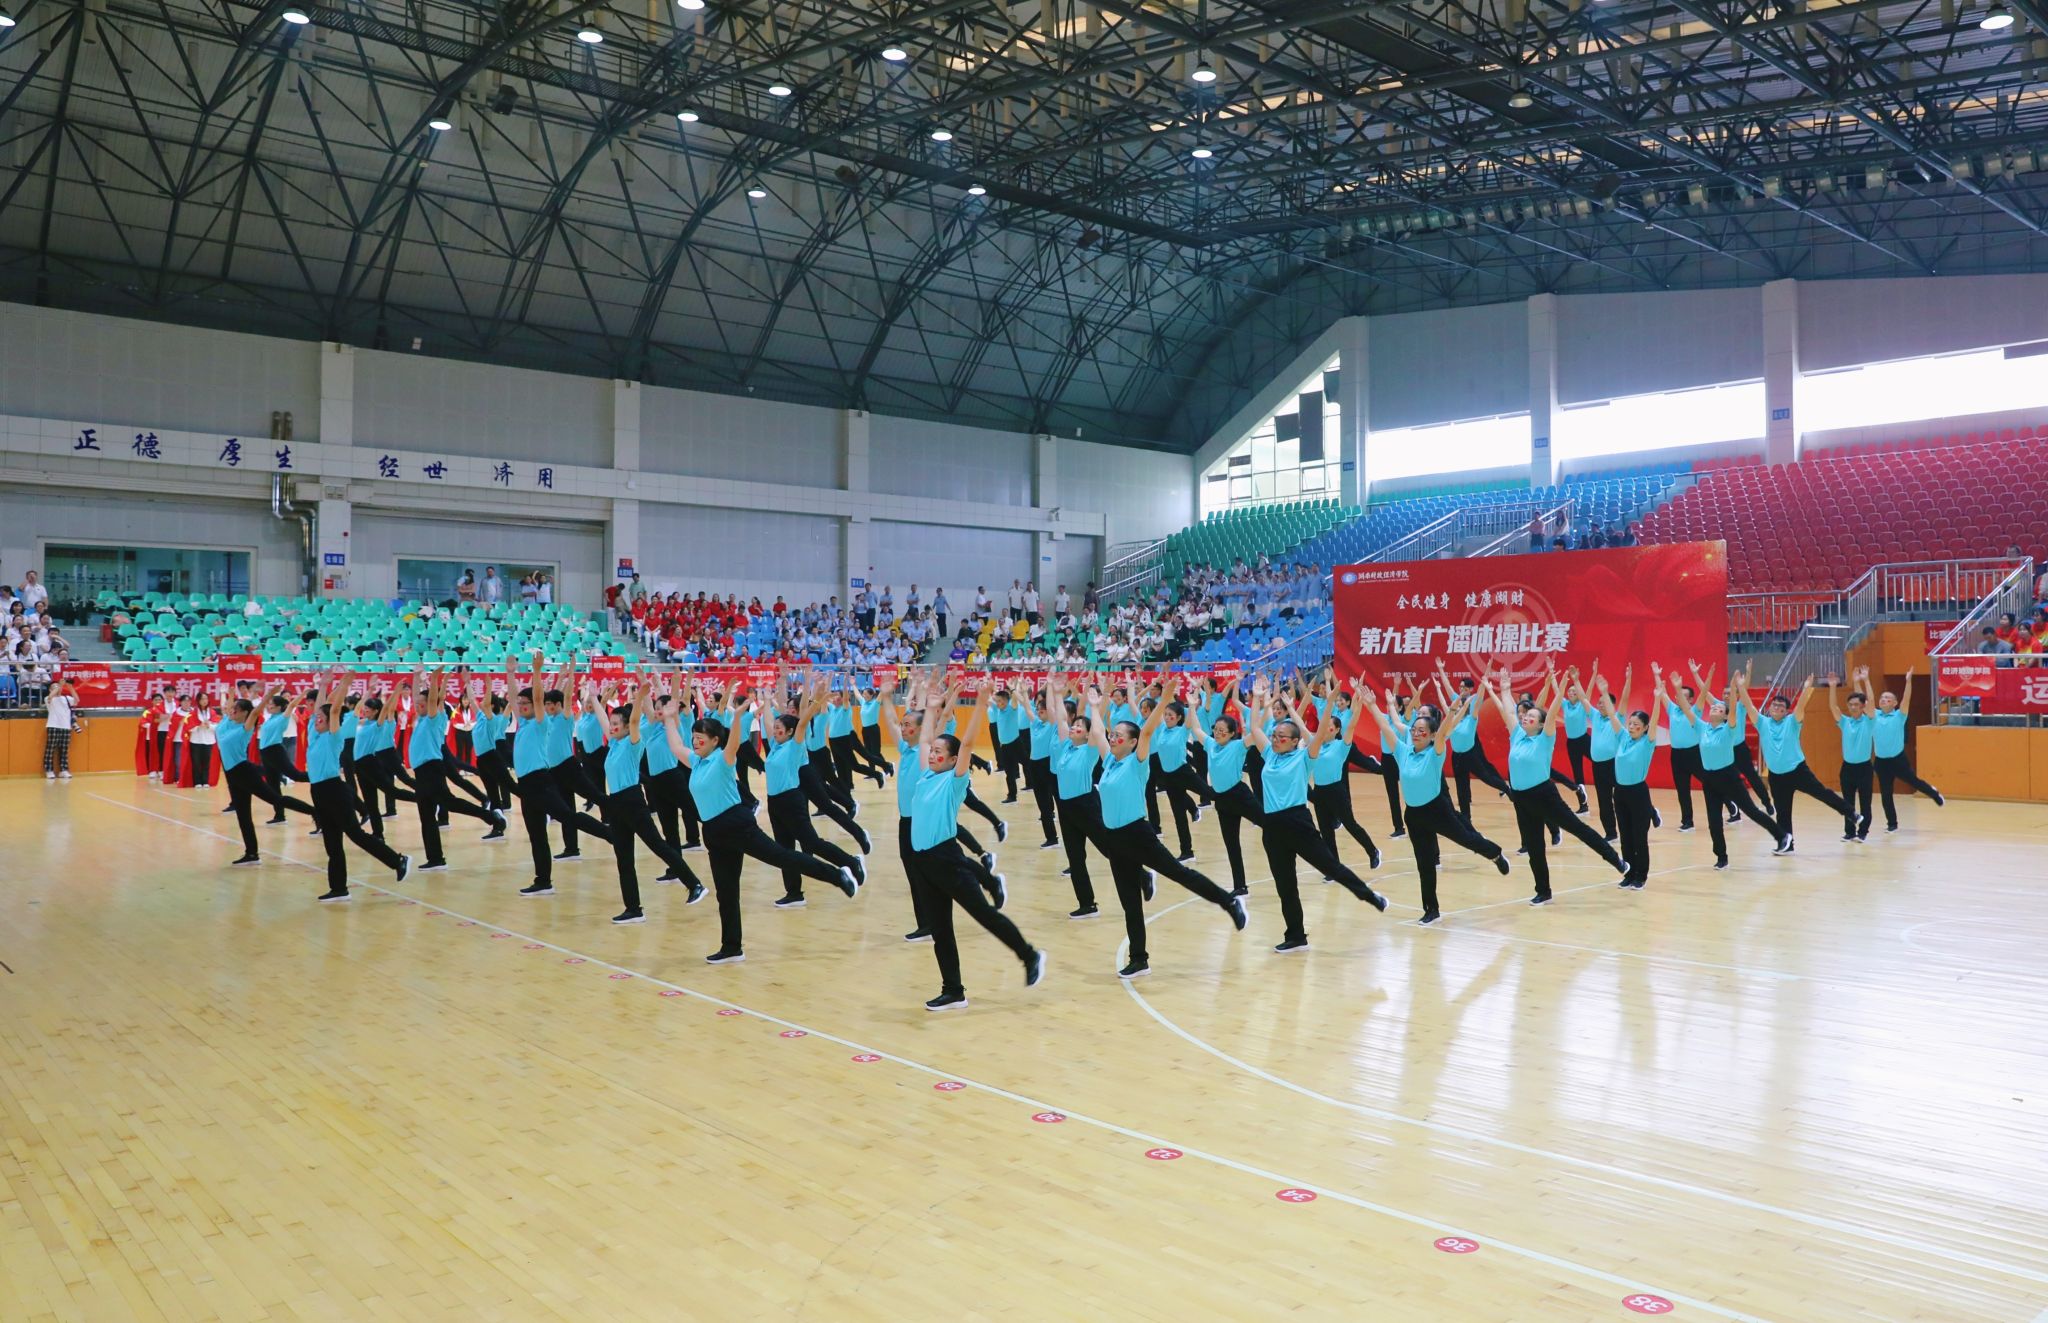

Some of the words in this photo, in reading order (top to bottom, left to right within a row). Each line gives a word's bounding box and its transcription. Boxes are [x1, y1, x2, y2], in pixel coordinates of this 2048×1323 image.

[1397, 592, 1450, 610] 全民健身
[1464, 589, 1525, 608] 健康湖财
[1359, 622, 1571, 655] 第九套广播体操比赛
[1150, 1148, 1176, 1159] 32
[1283, 1190, 1312, 1201] 34
[1438, 1238, 1474, 1252] 36
[1629, 1295, 1668, 1312] 38
